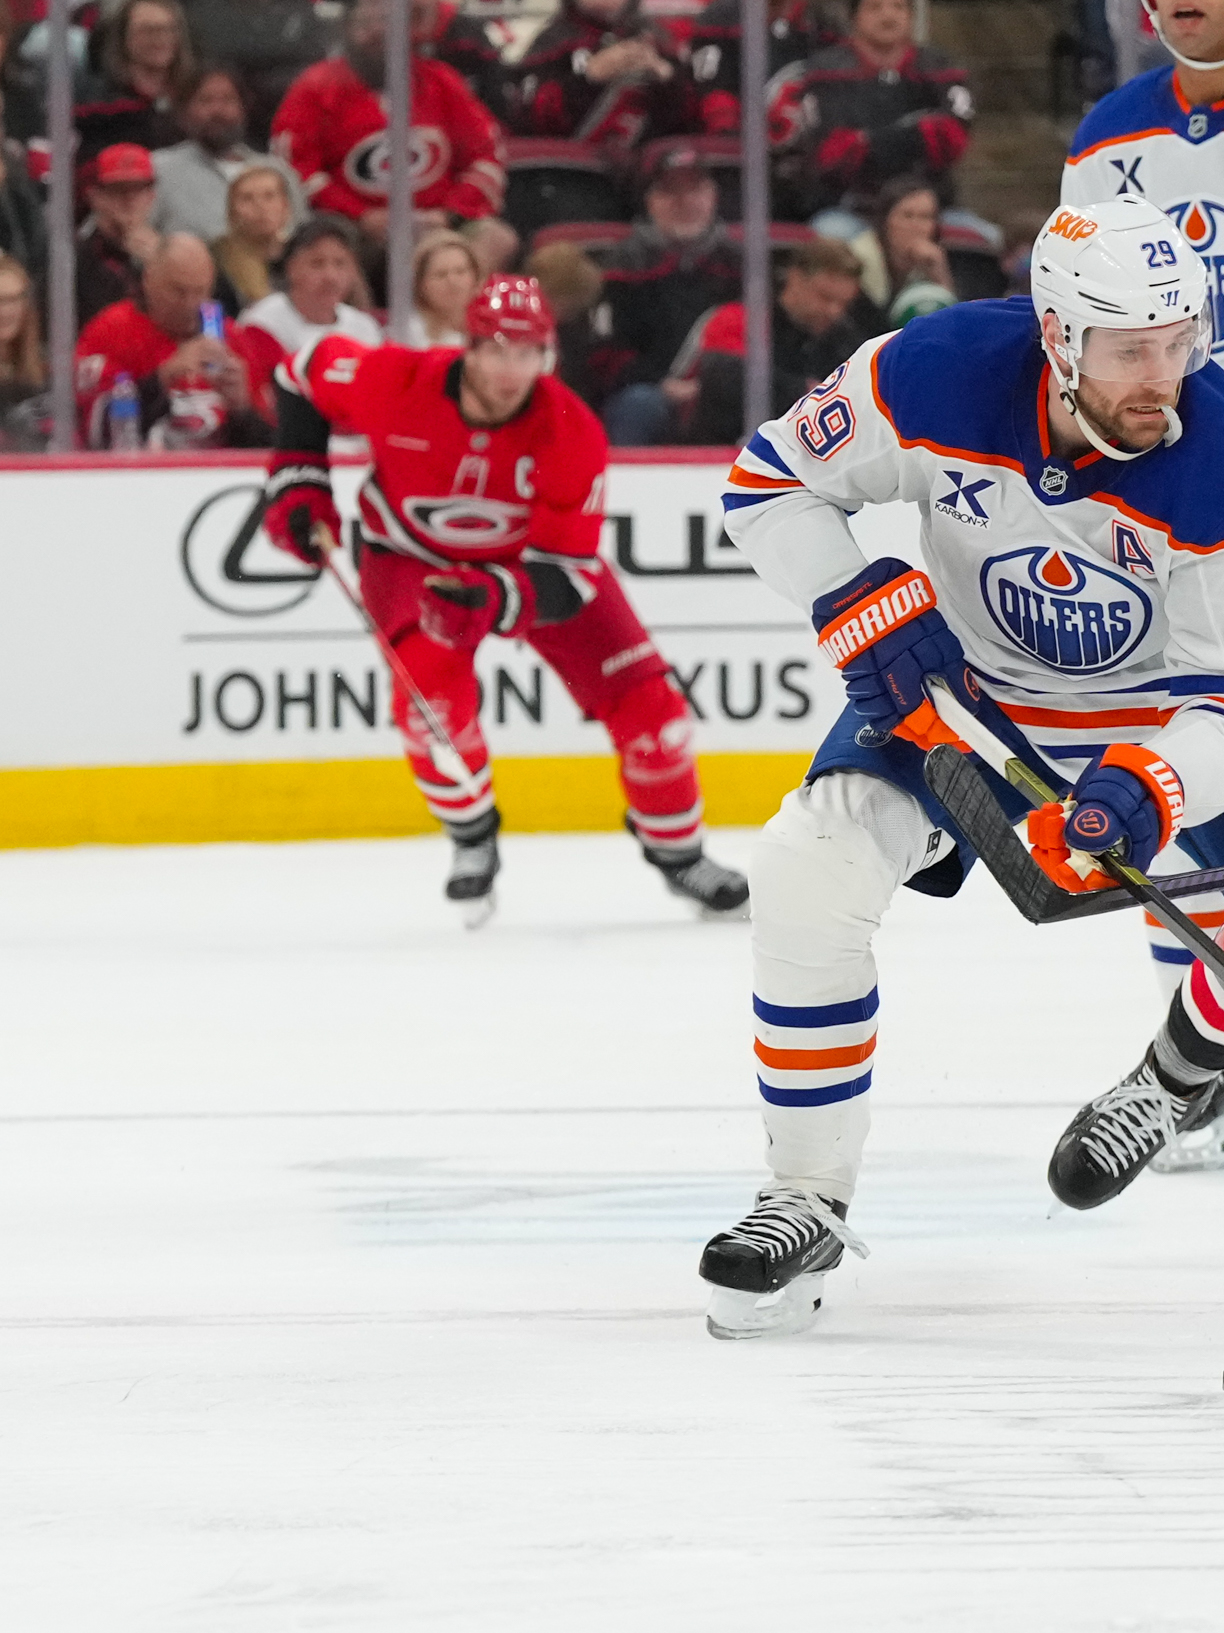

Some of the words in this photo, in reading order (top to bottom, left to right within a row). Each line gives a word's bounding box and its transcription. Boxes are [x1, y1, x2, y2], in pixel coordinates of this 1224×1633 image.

[1048, 210, 1098, 242] SKIP
[1141, 240, 1178, 270] 29
[515, 456, 535, 500] C
[934, 502, 989, 530] KARBON-X
[1111, 519, 1157, 576] A
[997, 577, 1133, 668] OILERS
